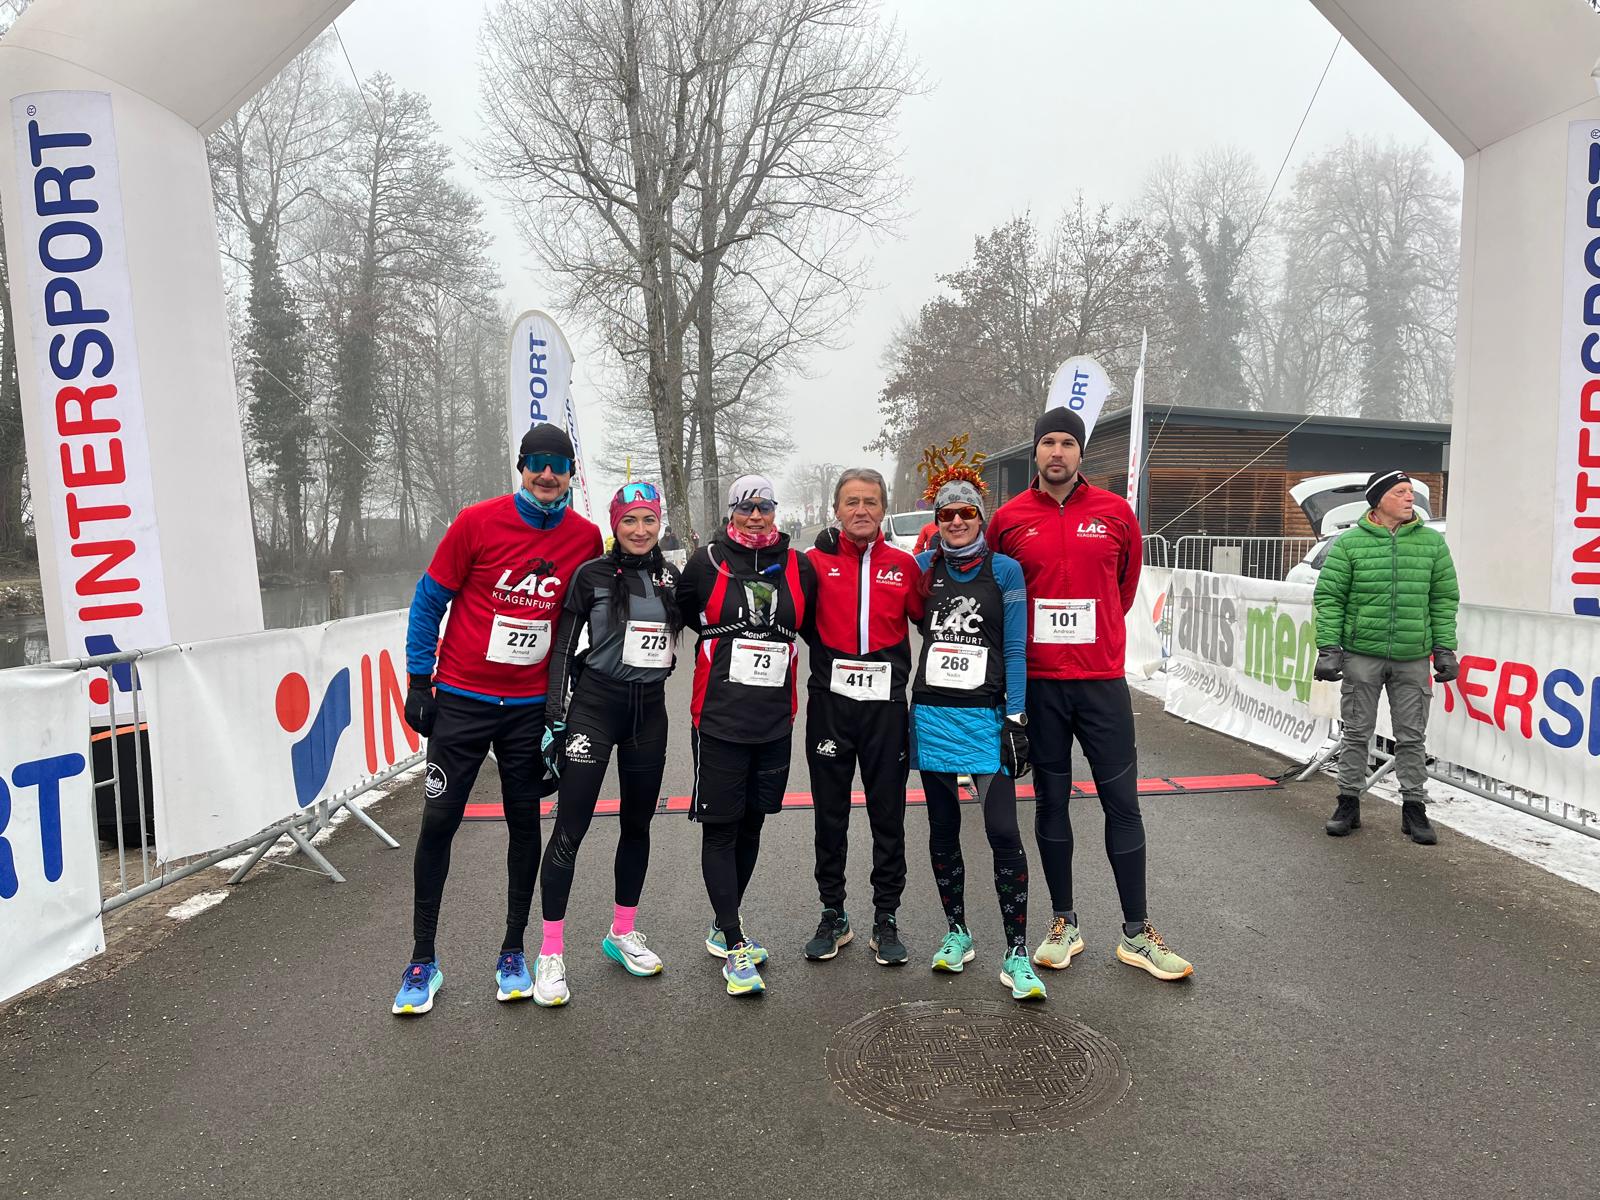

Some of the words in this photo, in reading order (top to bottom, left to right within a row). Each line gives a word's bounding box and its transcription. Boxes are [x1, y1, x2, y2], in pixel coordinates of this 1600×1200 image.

[28, 119, 144, 622] INTERSPORT
[1077, 523, 1107, 534] LAC
[494, 569, 562, 598] LAC
[876, 569, 904, 582] LAC
[492, 590, 557, 610] KLAGENFURT
[930, 610, 984, 634] LAC
[1050, 612, 1078, 627] 101
[1178, 572, 1238, 668] altis
[507, 631, 538, 648] 272
[640, 635, 667, 651] 273
[753, 653, 771, 669] 73
[940, 655, 969, 672] 268
[846, 673, 873, 688] 411
[1166, 662, 1216, 693] powered
[1215, 675, 1232, 706] by
[1231, 683, 1317, 745] humanomed
